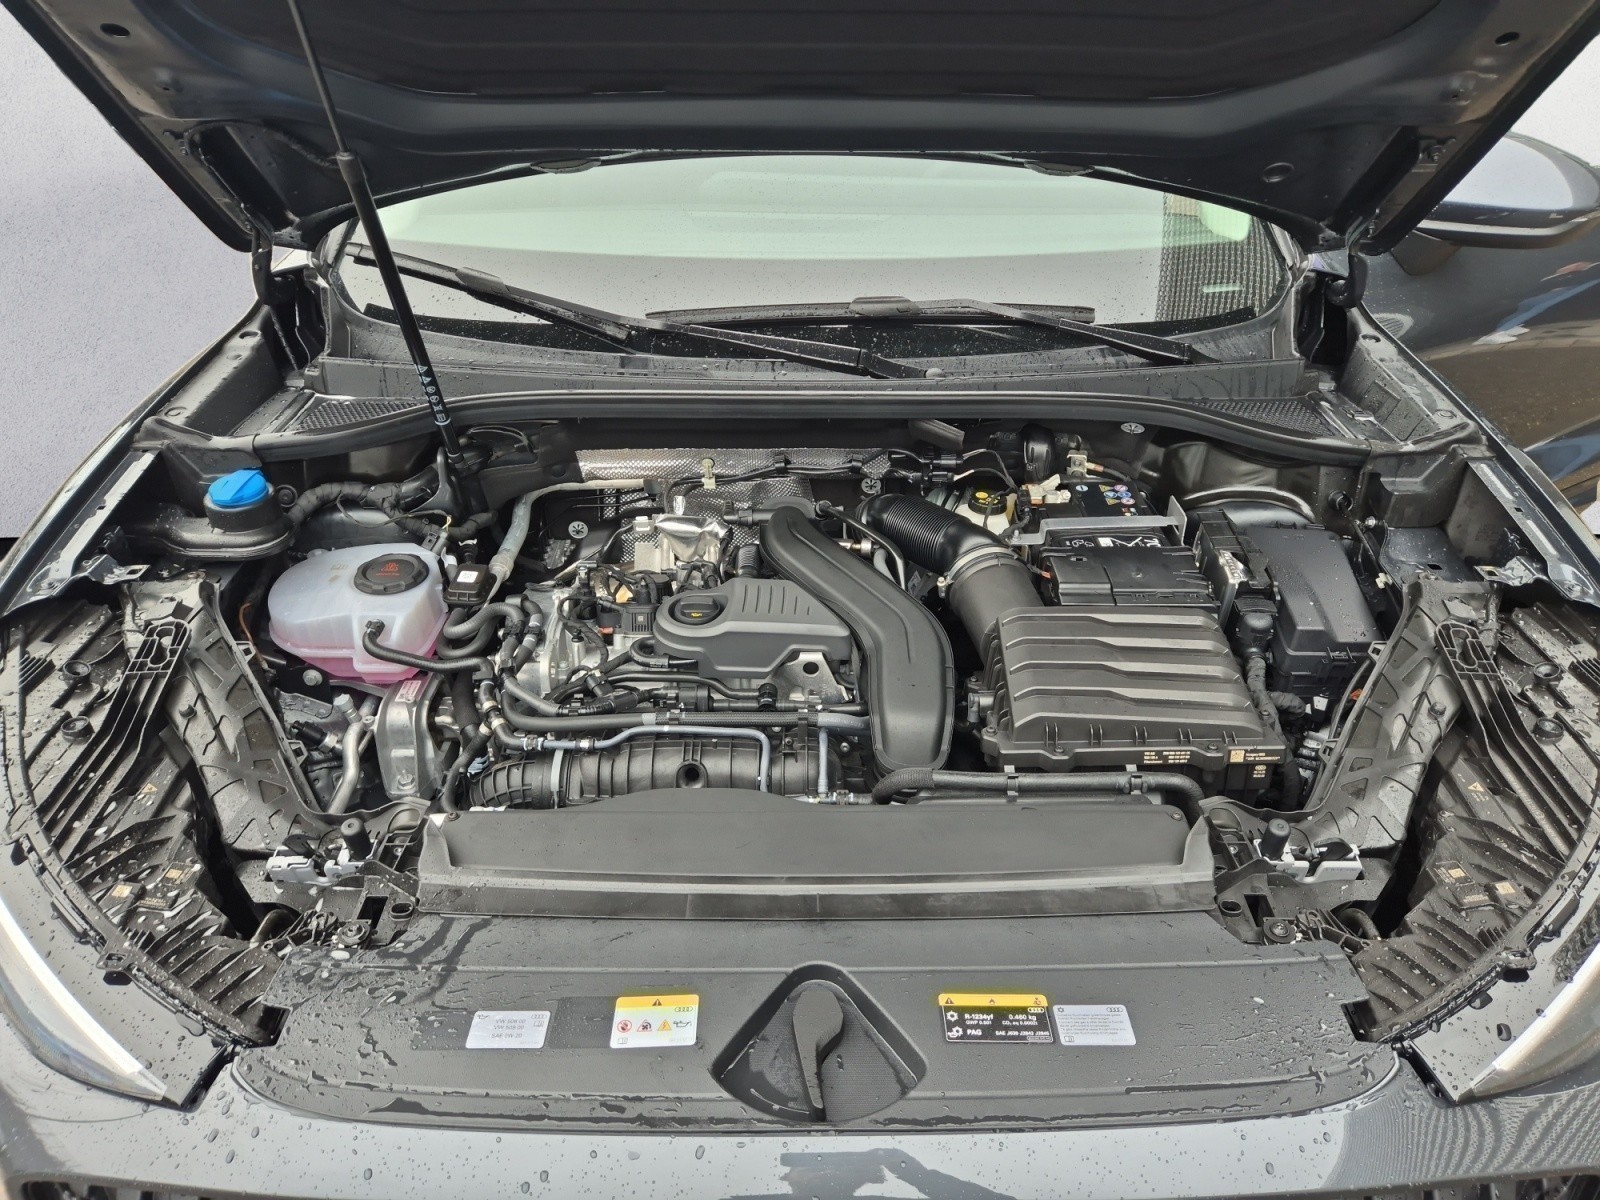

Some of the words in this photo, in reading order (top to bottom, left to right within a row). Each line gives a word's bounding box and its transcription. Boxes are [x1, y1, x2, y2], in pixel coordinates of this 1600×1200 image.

[964, 1013, 993, 1021] R-1234yf
[1028, 1013, 1037, 1021] kg
[967, 1028, 982, 1036] PAG
